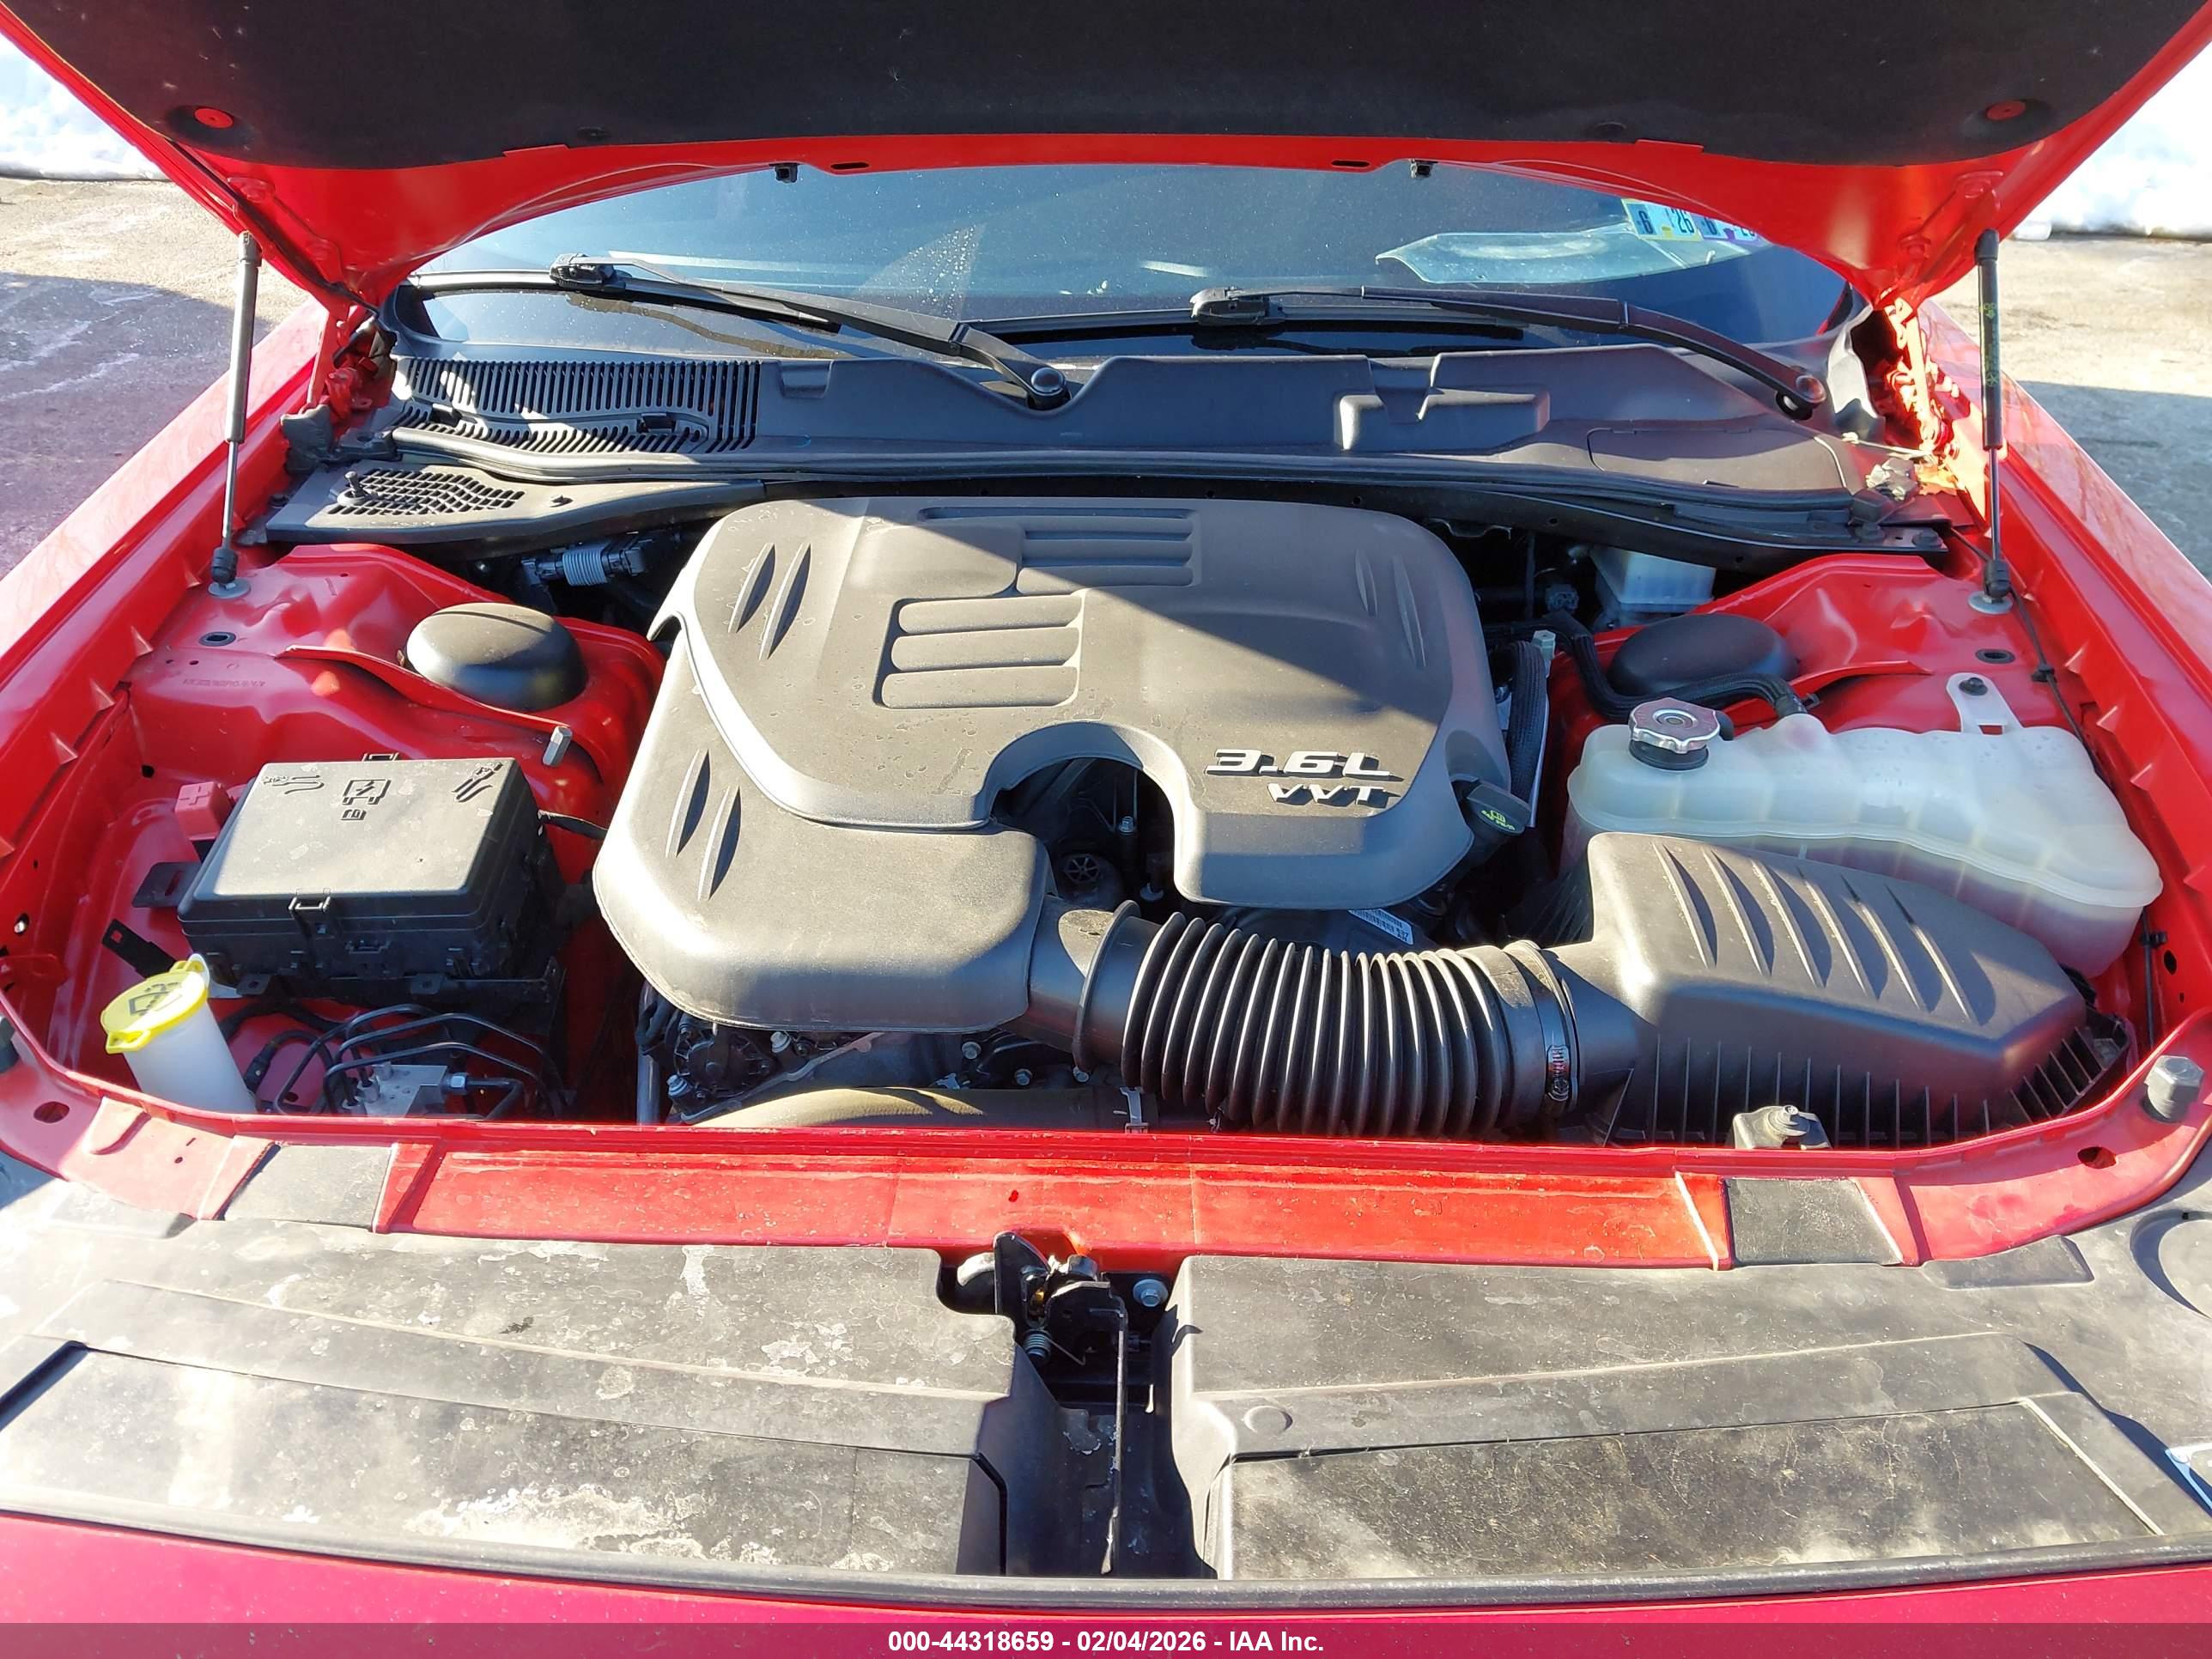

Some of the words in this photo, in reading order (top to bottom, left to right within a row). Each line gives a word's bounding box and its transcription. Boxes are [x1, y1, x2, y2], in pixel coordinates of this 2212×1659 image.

[1638, 210, 1654, 234] 6
[1204, 749, 1390, 777] 3.6L
[1267, 783, 1385, 805] VVT
